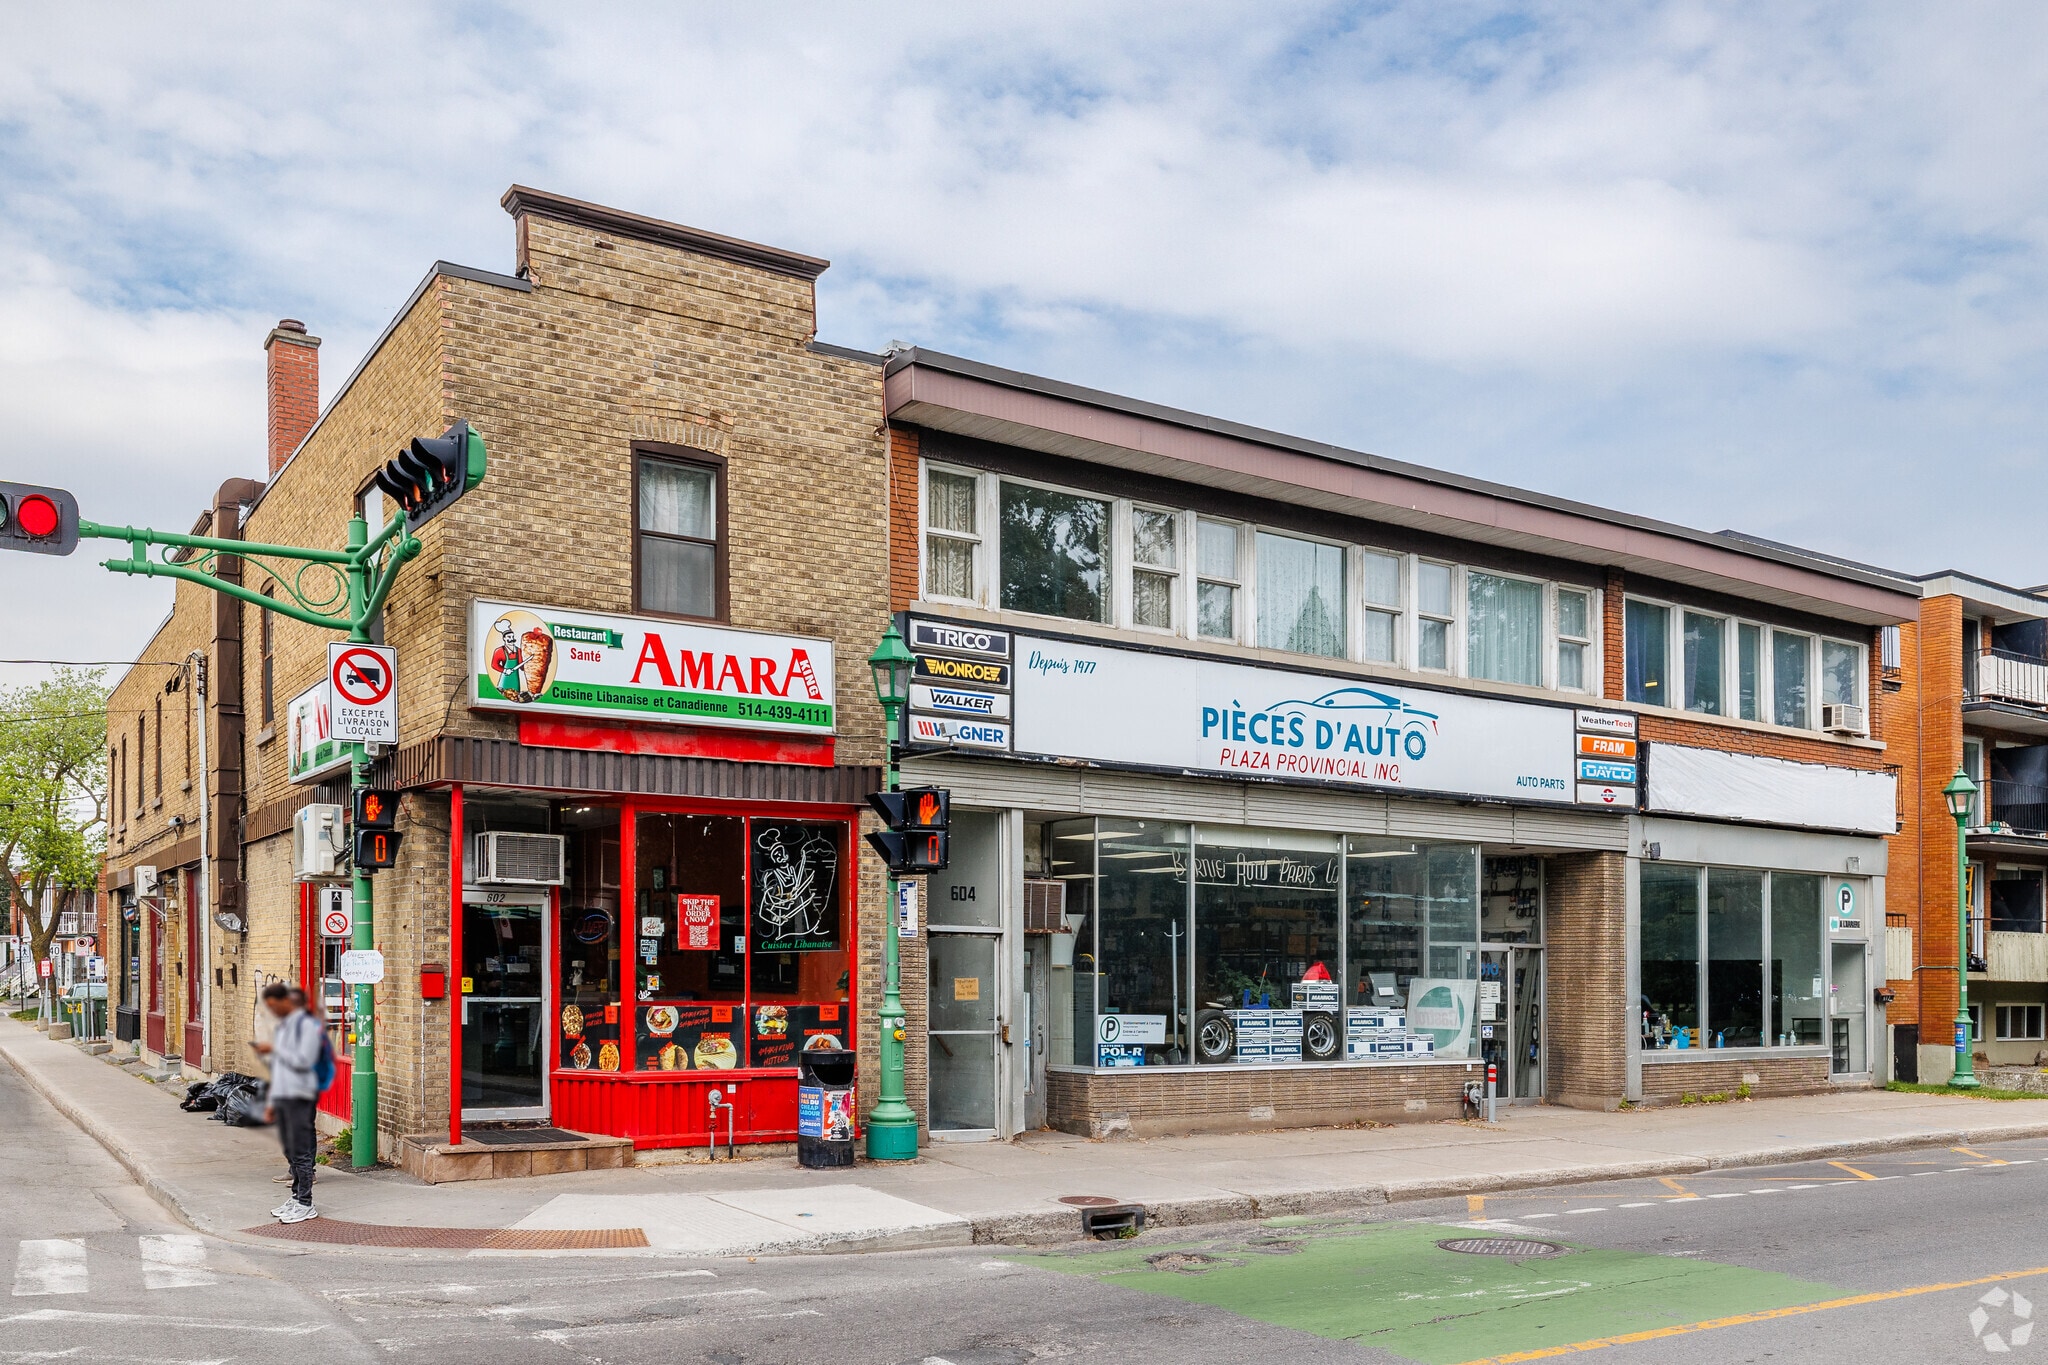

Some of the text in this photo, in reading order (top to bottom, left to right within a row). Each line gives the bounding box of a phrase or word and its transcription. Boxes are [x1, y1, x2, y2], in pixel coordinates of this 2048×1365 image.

[553, 625, 607, 642] Restaurant
[932, 628, 991, 650] TRICO
[570, 647, 602, 663] Santé
[1028, 650, 1097, 676] Depuis 1977
[799, 659, 819, 697] KING
[933, 660, 993, 681] MONROE
[552, 686, 828, 723] Cuisine Libanaise et Canadienne 514-439-4111
[930, 688, 994, 714] WALKER
[338, 717, 390, 728] LIVRAISON
[1202, 699, 1305, 748] PIÈCES
[1581, 715, 1633, 728] WeatherTech
[345, 726, 382, 736] LOCALE
[1592, 739, 1626, 754] FRAM
[1220, 748, 1401, 783] PLAZA PROVINCIAL INC.
[1585, 764, 1633, 781] DAYCO
[1516, 775, 1565, 790] AUTO PARTS
[1279, 856, 1316, 884] PARTS
[486, 893, 506, 903] 602
[682, 898, 699, 906] SKIP
[950, 885, 976, 902] 604
[761, 939, 833, 950] Cuisine Libanaise
[1100, 1047, 1143, 1057] POL-R
